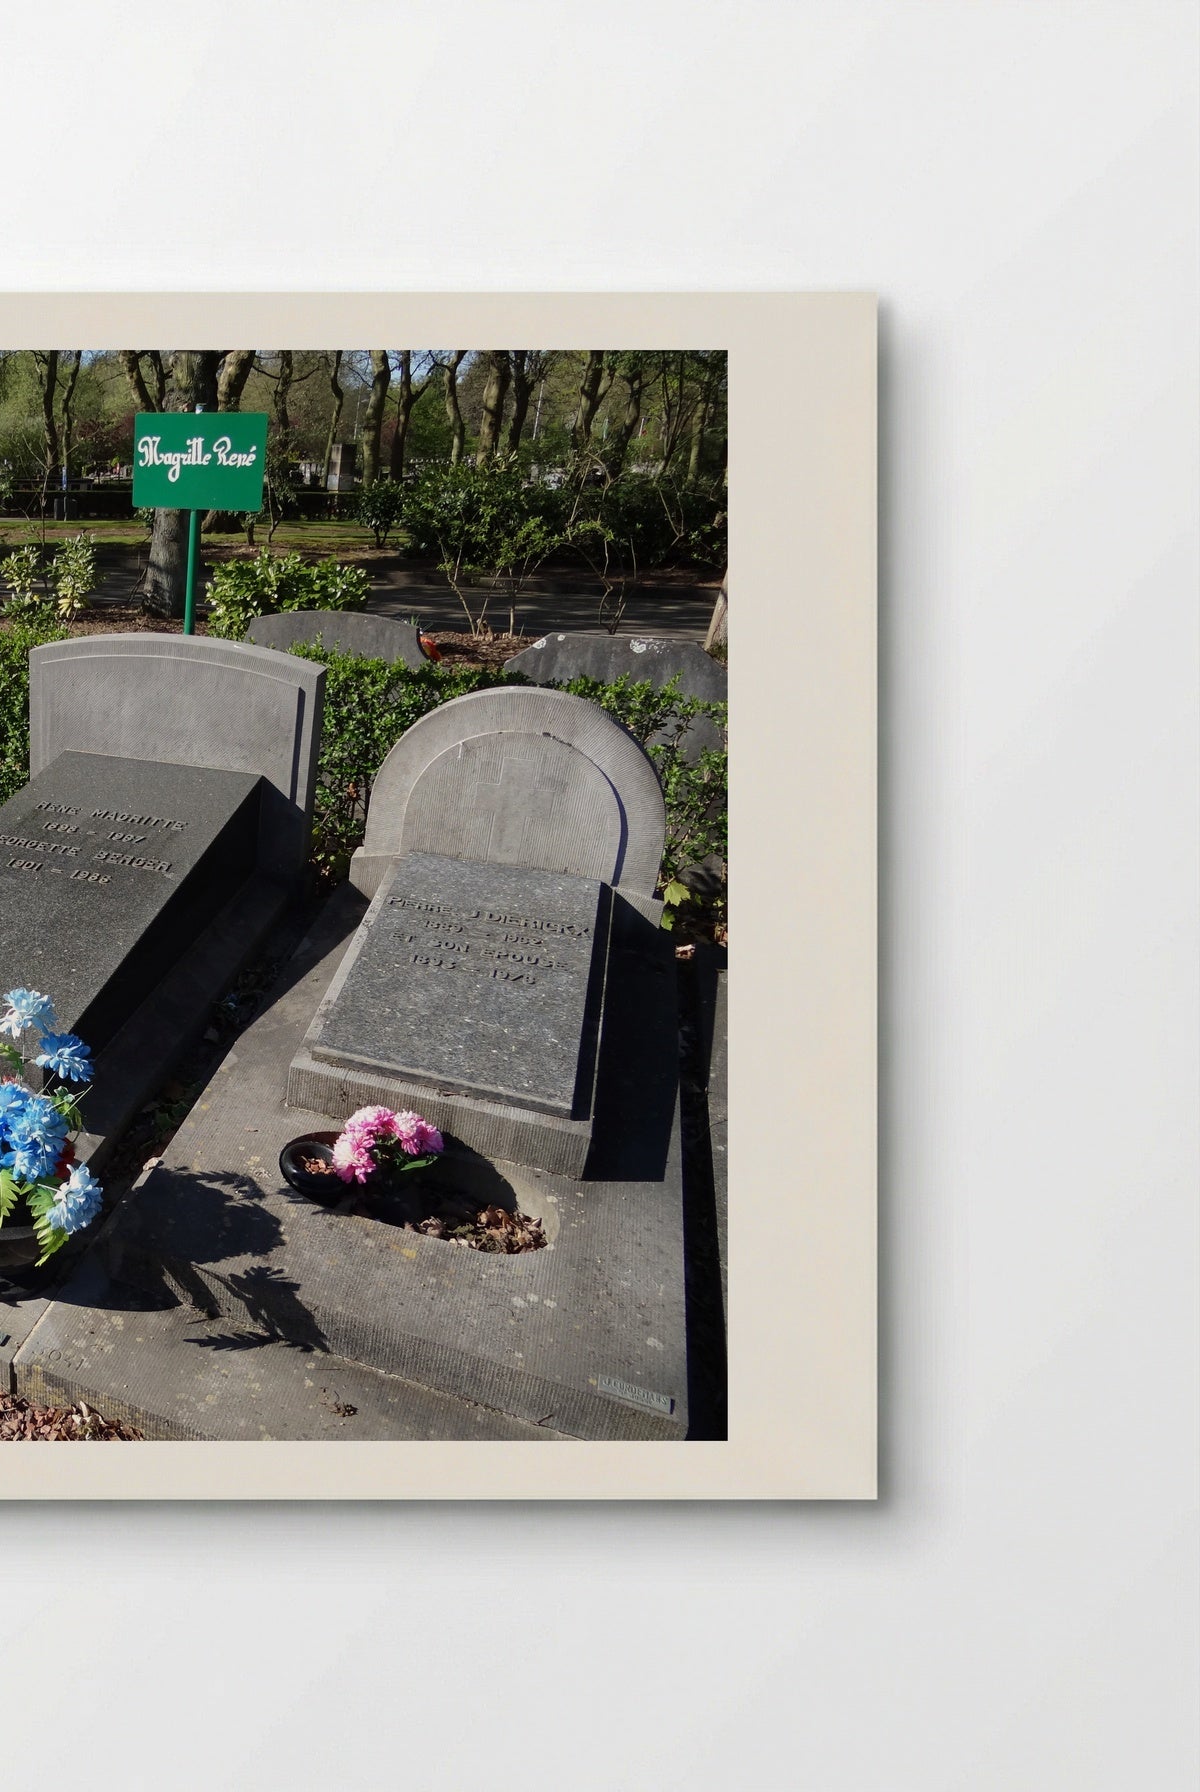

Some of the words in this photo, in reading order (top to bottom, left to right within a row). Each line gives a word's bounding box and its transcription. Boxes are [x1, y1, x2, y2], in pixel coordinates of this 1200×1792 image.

[137, 436, 212, 483] Magritte
[212, 436, 257, 468] René
[90, 808, 189, 831] MAGRITTE
[6, 858, 43, 872] 1901
[92, 850, 173, 872] BERGER
